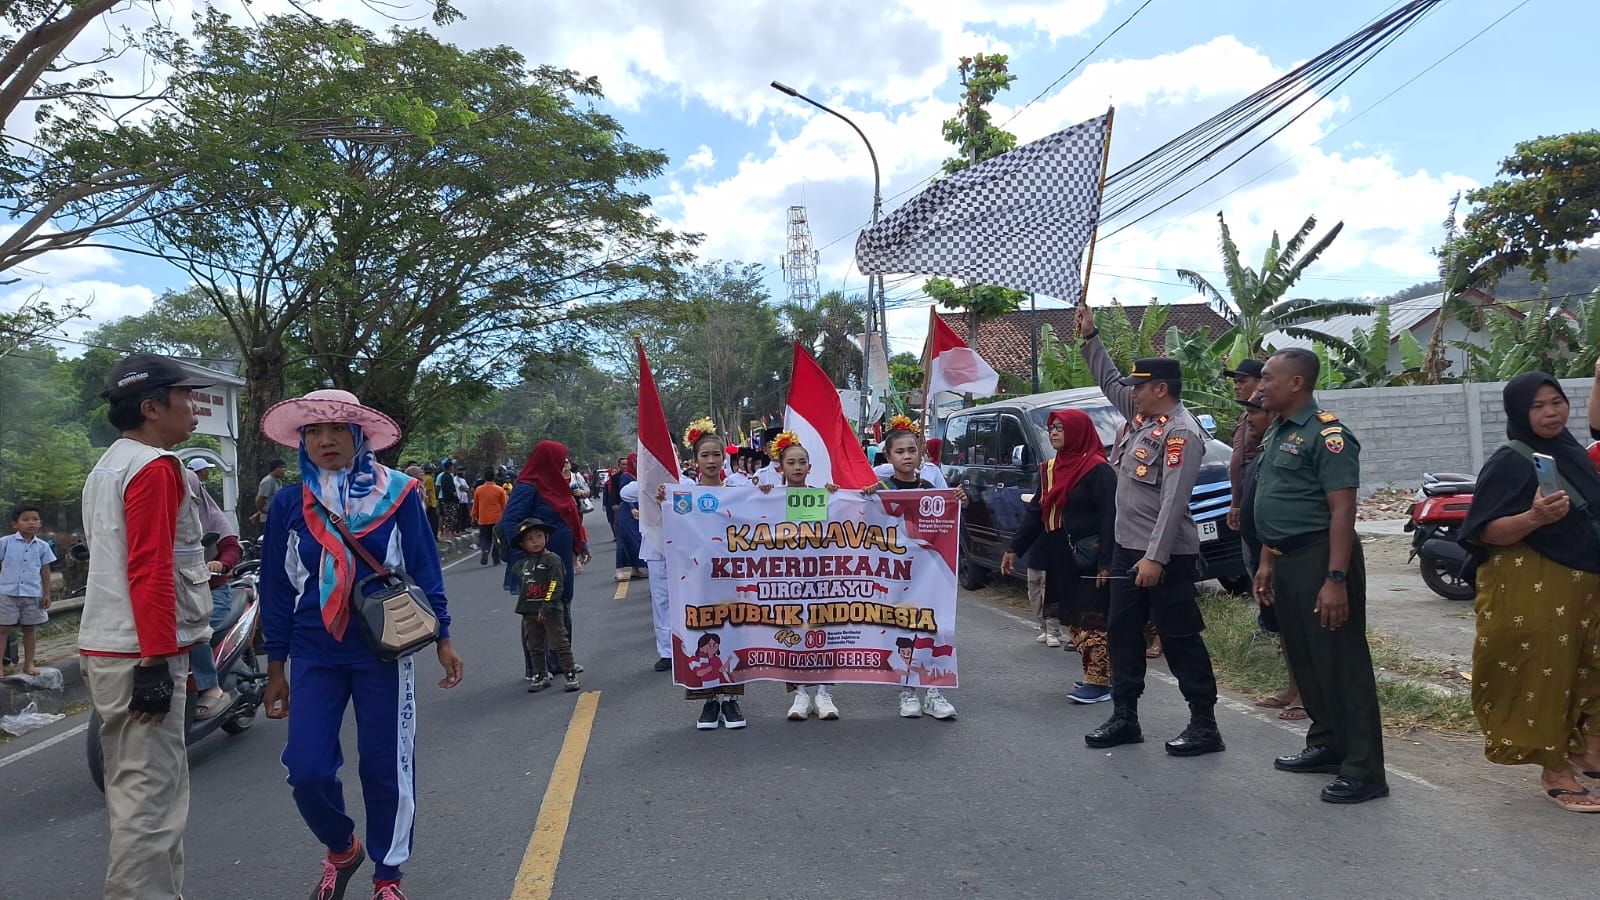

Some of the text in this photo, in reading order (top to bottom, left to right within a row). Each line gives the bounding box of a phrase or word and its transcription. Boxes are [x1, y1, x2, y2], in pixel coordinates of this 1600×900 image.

[1141, 437, 1160, 450] POLRI
[788, 494, 826, 508] 001
[919, 495, 945, 517] 80
[726, 521, 907, 553] KARNAVAL
[1202, 523, 1216, 535] EB
[711, 555, 912, 580] KEMERDEKAAN
[757, 580, 874, 600] DIRGAHAYU
[685, 602, 937, 632] REPUBLIK INDONESIA
[774, 629, 826, 648] Ke 80
[747, 650, 881, 667] SDN 1 DASAN GERES
